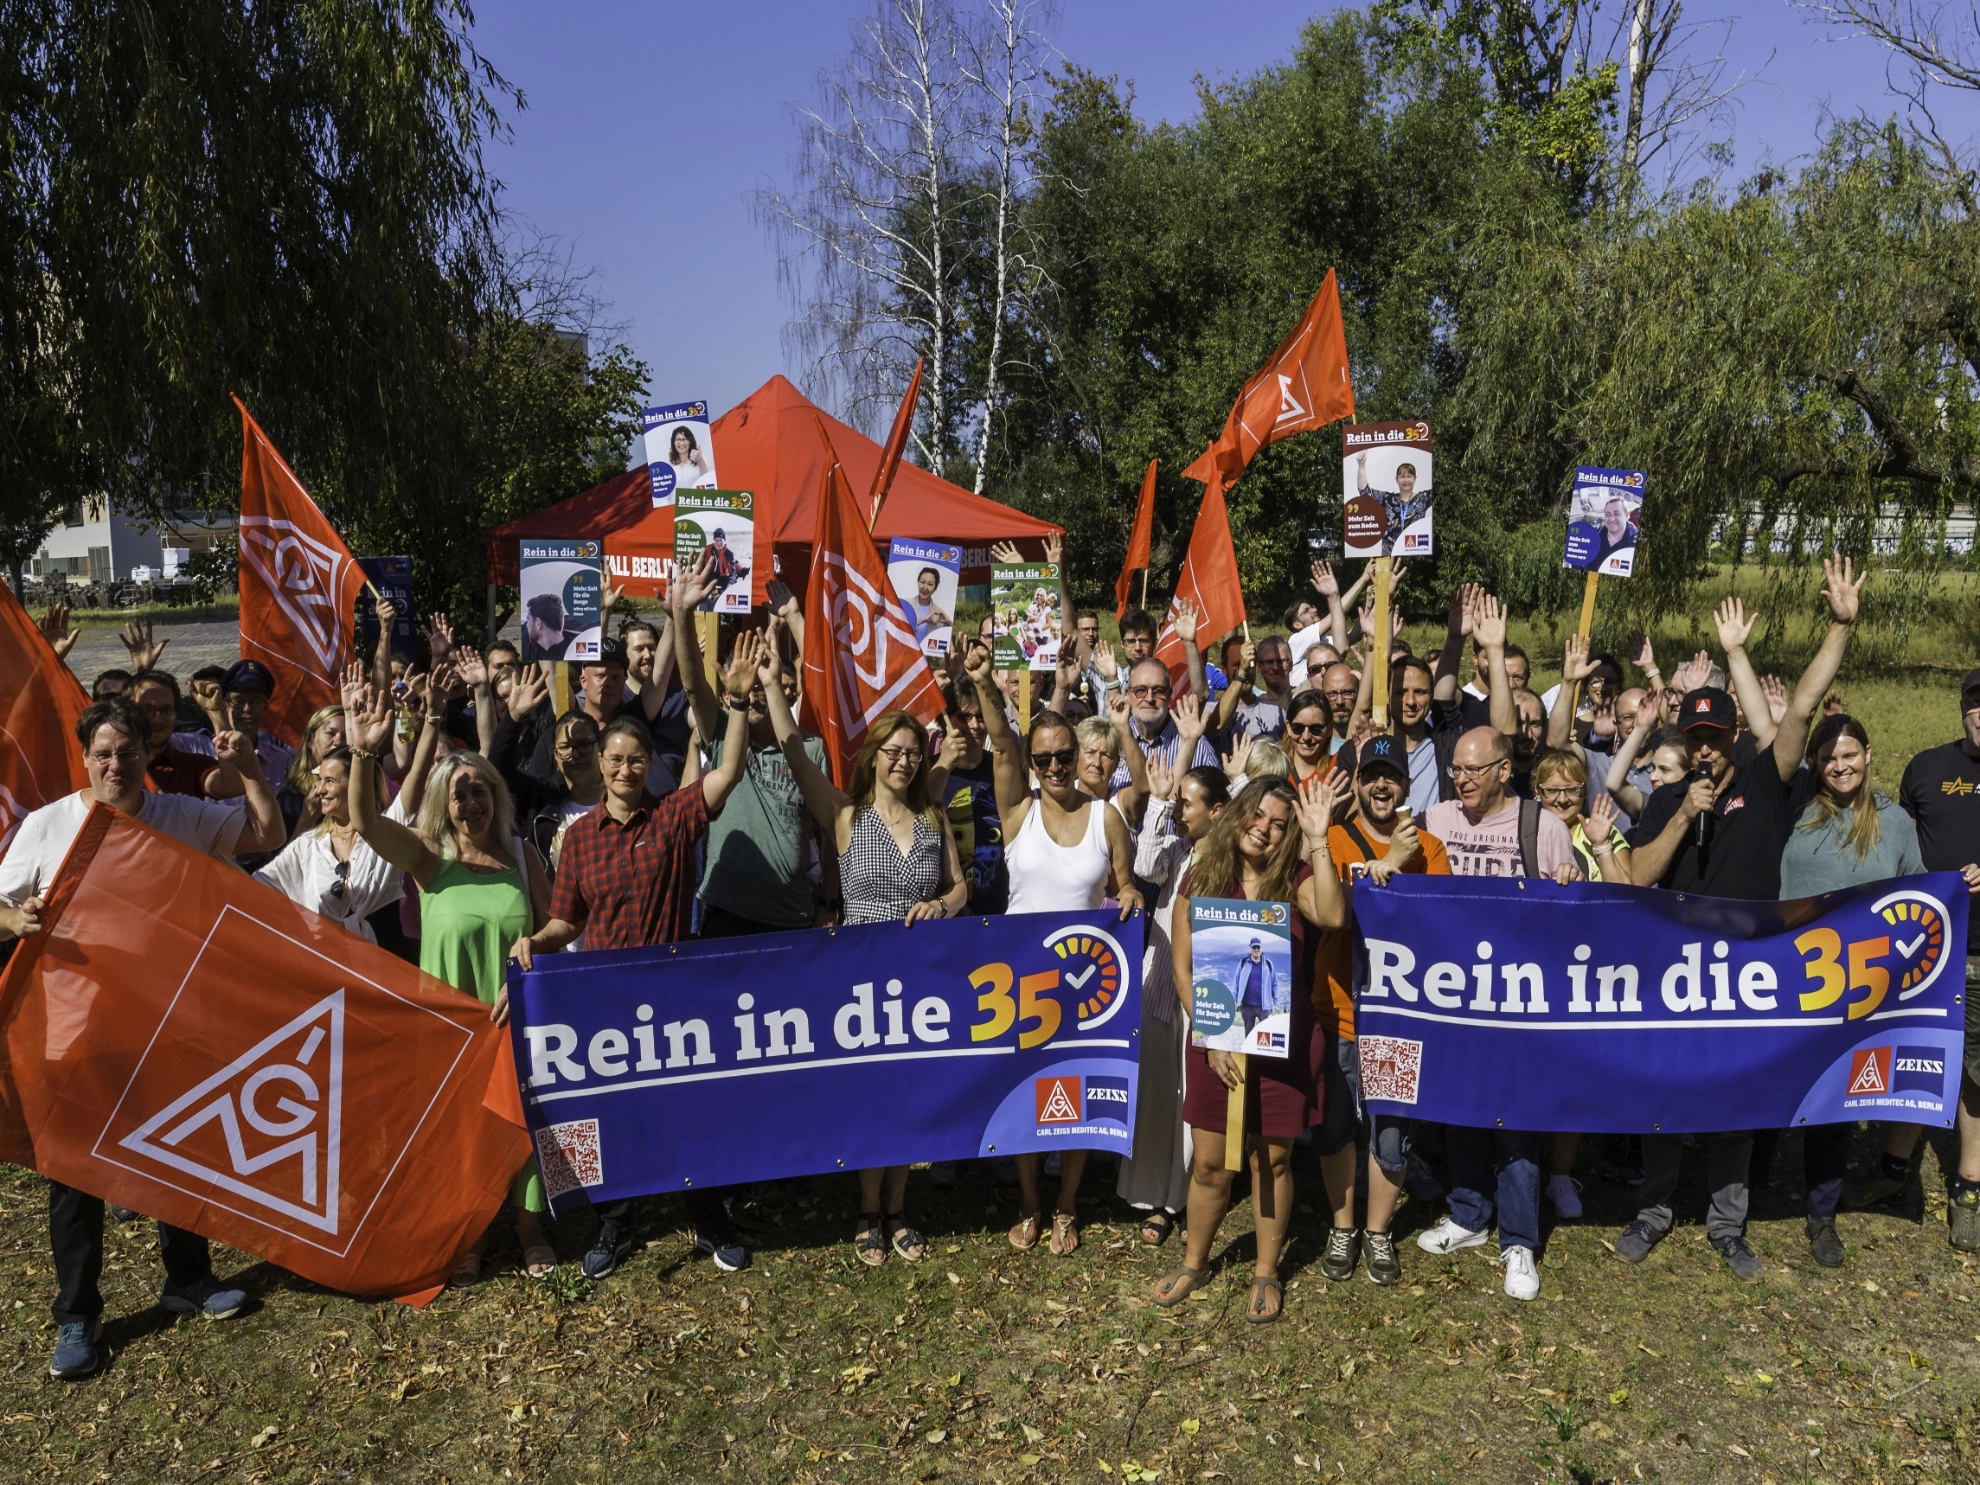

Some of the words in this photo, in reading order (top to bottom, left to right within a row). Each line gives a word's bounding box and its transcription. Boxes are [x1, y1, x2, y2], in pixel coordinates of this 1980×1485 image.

[644, 412, 664, 423] Rein
[665, 410, 674, 420] in
[674, 409, 688, 418] die
[1346, 432, 1372, 443] Rein
[1374, 430, 1386, 441] in
[1387, 430, 1404, 440] die
[1406, 427, 1420, 441] 35
[1578, 472, 1598, 482] Rein
[1600, 474, 1608, 483] in
[1610, 475, 1624, 484] die
[678, 496, 701, 506] Rein
[702, 496, 712, 506] in
[714, 497, 730, 506] die
[730, 496, 744, 509] 35
[523, 547, 546, 557] Rein
[548, 547, 558, 557] in
[560, 548, 576, 557] die
[577, 546, 590, 559] 35
[894, 544, 914, 554] Rein
[916, 546, 925, 556] in
[926, 548, 940, 558] die
[994, 568, 1014, 578] Rein
[1015, 568, 1024, 578] in
[1026, 568, 1040, 578] die
[367, 587, 393, 598] Rin
[1449, 830, 1468, 841] TRUE
[1194, 906, 1222, 918] Rein
[1224, 908, 1238, 920] in
[1239, 910, 1258, 922] die
[1260, 909, 1276, 924] 35
[1360, 938, 1550, 1013] Rein
[1566, 944, 1642, 1013] in
[1660, 940, 1778, 1012] die
[1793, 928, 1890, 1020] 35
[1196, 1000, 1212, 1009] Mehr
[1212, 1002, 1225, 1010] Zeit
[1206, 1010, 1230, 1020] Bergluft
[524, 1004, 716, 1088] Rein
[734, 992, 814, 1061] in
[833, 978, 950, 1050] die
[968, 962, 1062, 1050] 35
[1896, 1058, 1944, 1074] ZEISS
[1086, 1088, 1128, 1103] ZEISS
[1844, 1100, 1858, 1108] CARL
[1859, 1098, 1876, 1107] ZEISS
[1876, 1098, 1904, 1107] MEDITEC
[1904, 1100, 1917, 1109] AG,
[1918, 1100, 1944, 1112] BERLIN
[1036, 1128, 1052, 1136] CARL
[1053, 1127, 1070, 1136] ZEISS
[1072, 1126, 1098, 1134] MEDITEC
[1098, 1127, 1109, 1136] AG,
[1110, 1128, 1128, 1139] BERLIN
